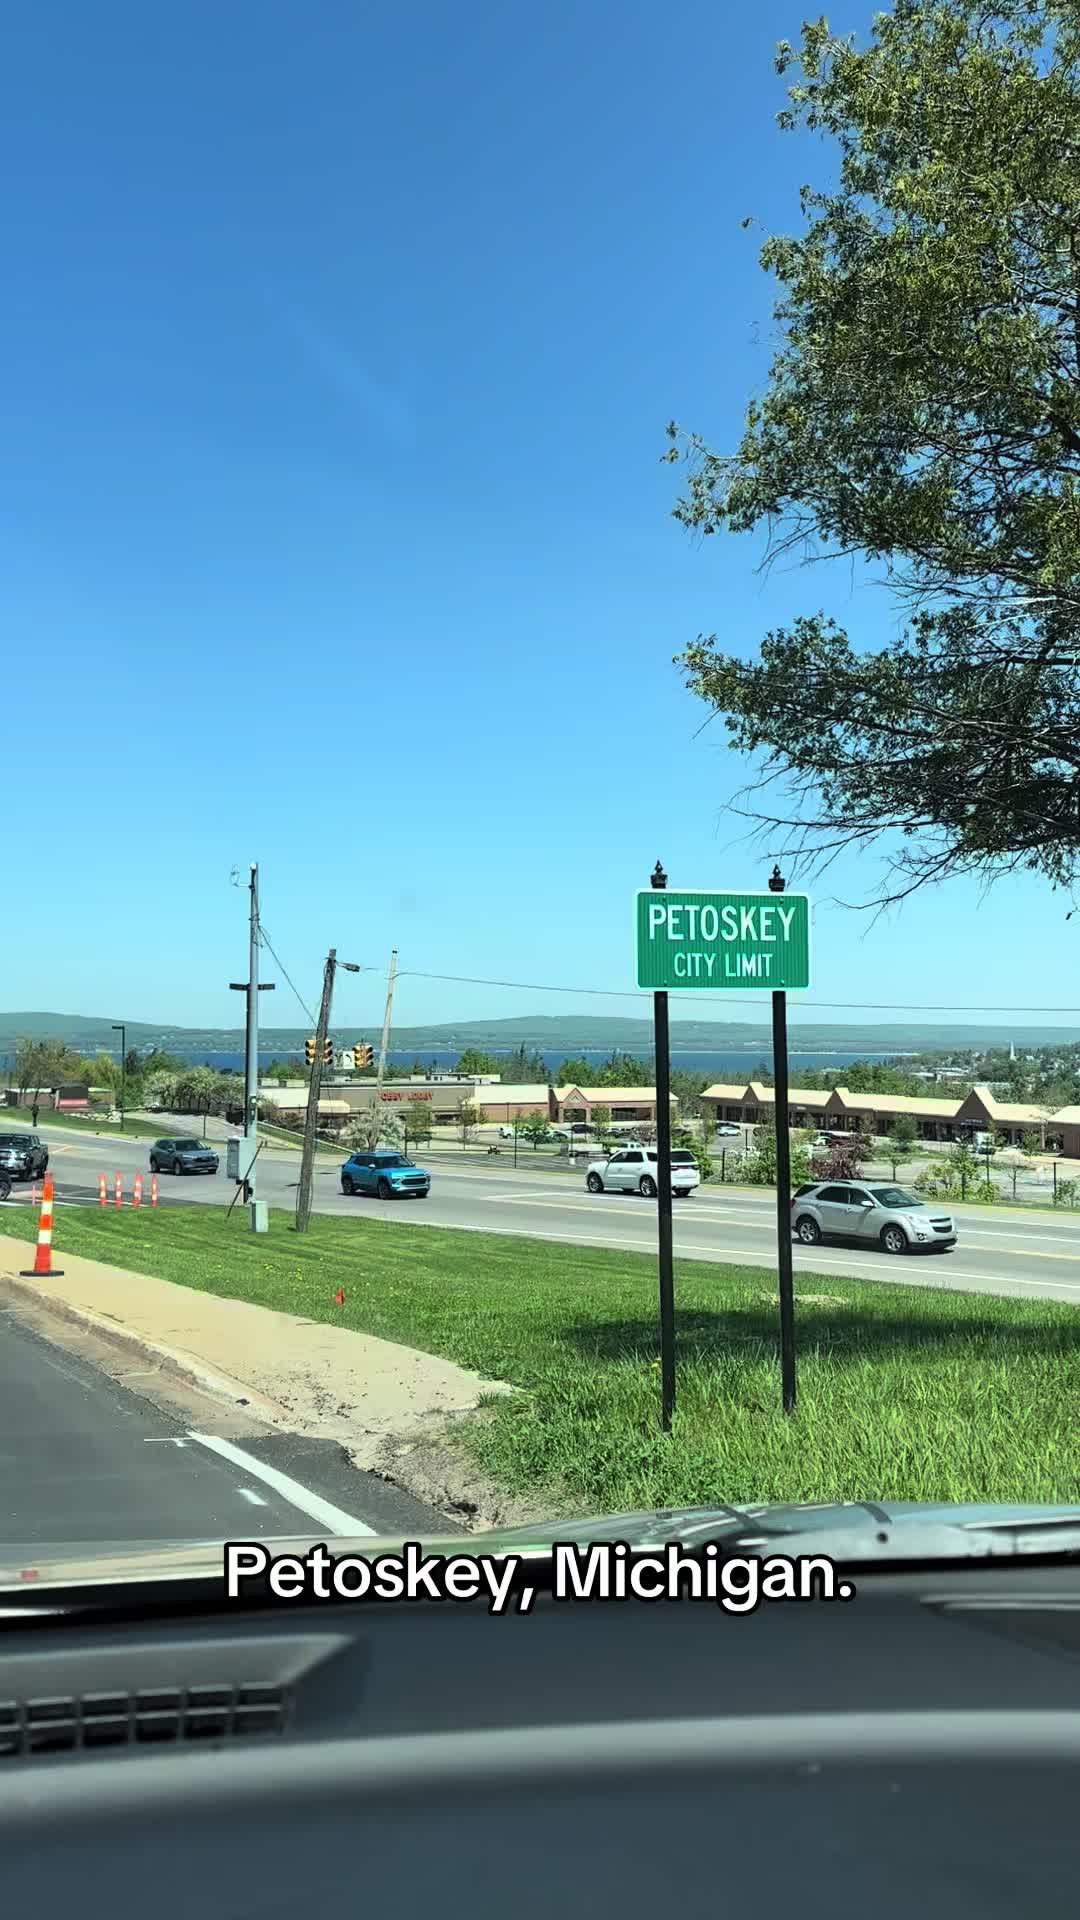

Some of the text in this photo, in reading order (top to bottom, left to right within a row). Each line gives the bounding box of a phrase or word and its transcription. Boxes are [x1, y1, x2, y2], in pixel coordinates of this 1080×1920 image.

[648, 904, 796, 942] PETOSKEY
[674, 952, 773, 977] CITY LIMIT
